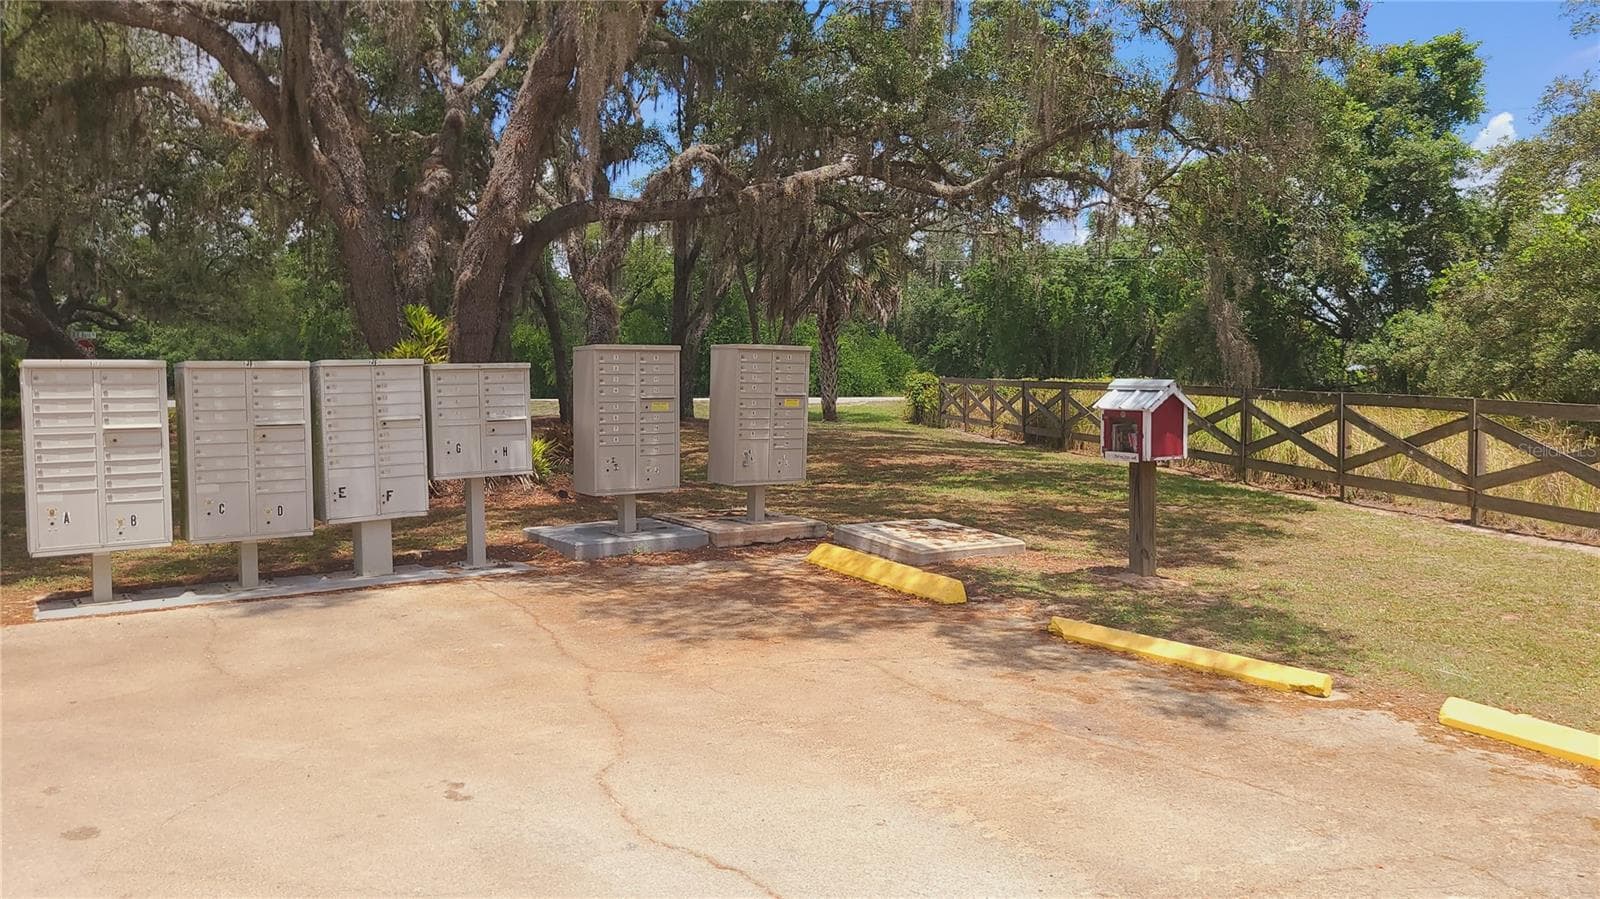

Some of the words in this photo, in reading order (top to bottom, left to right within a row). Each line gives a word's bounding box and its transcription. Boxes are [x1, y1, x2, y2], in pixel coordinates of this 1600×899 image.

[456, 443, 461, 453] G
[502, 446, 508, 456] H
[338, 487, 347, 498] E
[386, 490, 394, 501] F
[219, 503, 225, 514] C
[277, 505, 283, 516] D
[64, 513, 70, 524] A
[131, 515, 137, 526] B
